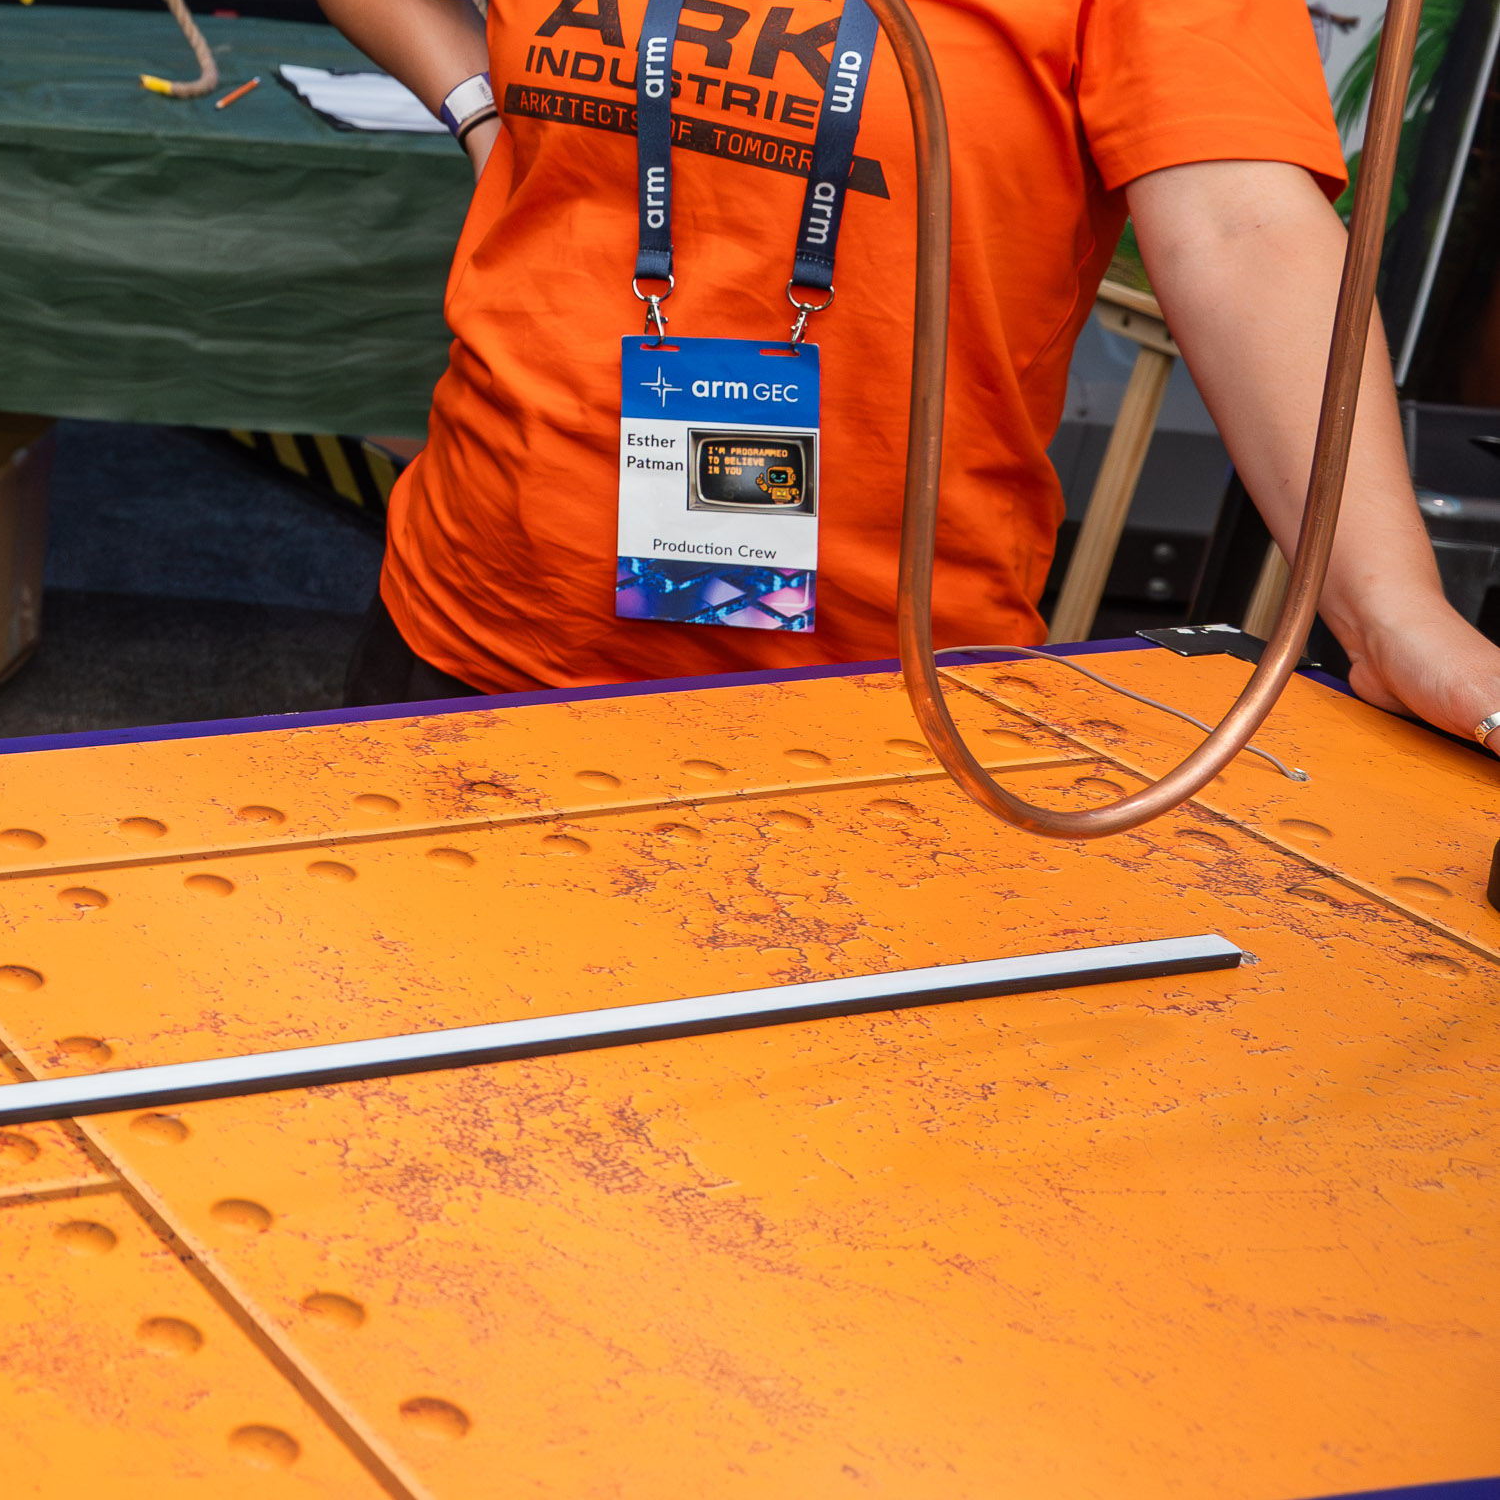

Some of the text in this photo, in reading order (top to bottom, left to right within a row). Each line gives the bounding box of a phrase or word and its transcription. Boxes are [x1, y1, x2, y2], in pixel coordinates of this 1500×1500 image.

[645, 36, 668, 99] arm
[525, 45, 819, 130] INDUTRIE
[830, 50, 863, 114] arm
[713, 129, 854, 177] TOMORR
[646, 166, 665, 229] arm
[806, 181, 837, 245] arm
[692, 379, 799, 403] arm GEC
[627, 433, 676, 449] Esther
[730, 447, 788, 458] PROGRAMMED
[626, 456, 684, 472] Patman
[708, 455, 765, 467] TO BELIEVE
[708, 465, 743, 476] IN YOU
[653, 538, 777, 560] Production Crew
